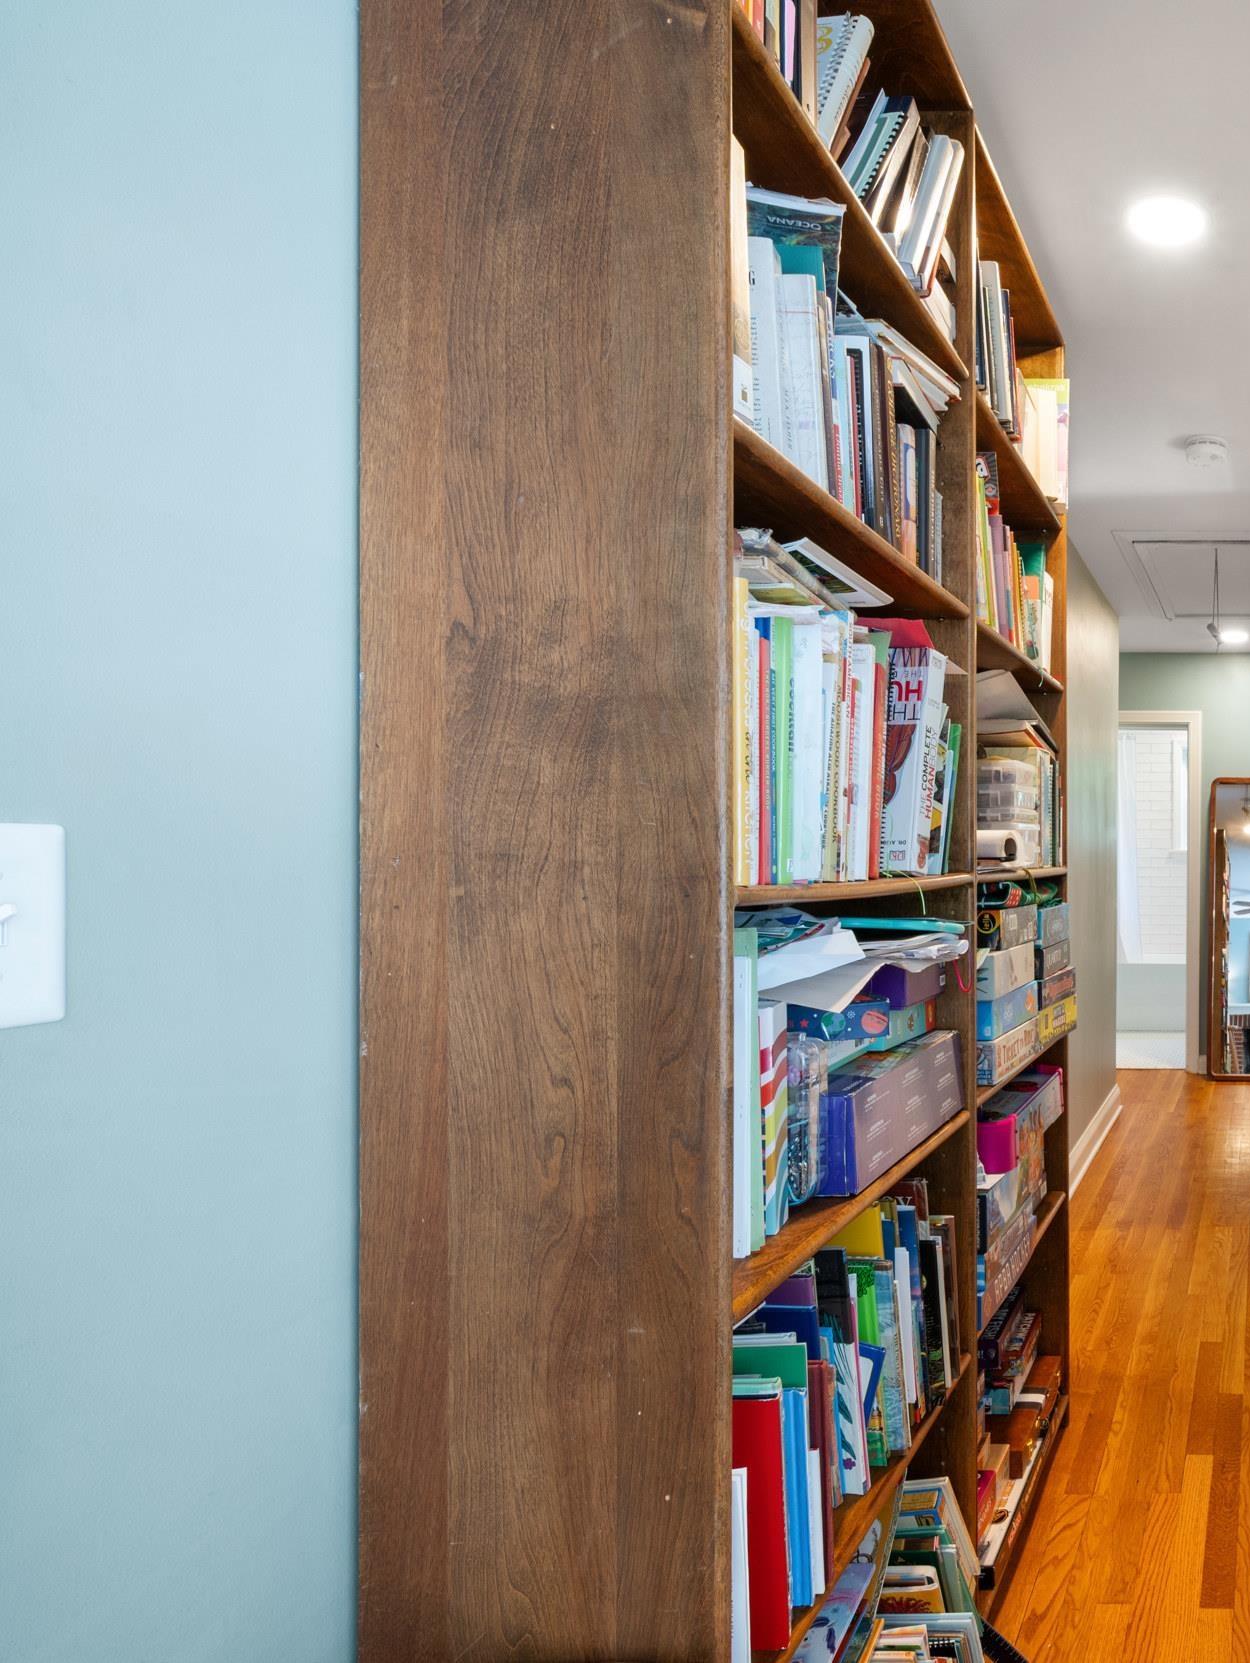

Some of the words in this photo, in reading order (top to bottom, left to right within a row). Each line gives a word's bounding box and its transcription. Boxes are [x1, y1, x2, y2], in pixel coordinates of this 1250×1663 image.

[746, 215, 822, 231] OCEANA
[887, 379, 898, 448] COLLEGE
[891, 451, 902, 538] DICTIONARY
[834, 684, 842, 767] MOOSEWOOD
[921, 727, 933, 791] COMPLETE
[832, 770, 840, 844] COOKBOOK
[920, 790, 928, 815] THE
[924, 766, 936, 820] HUMAN
[1002, 1039, 1019, 1064] TICKET
[1024, 1028, 1034, 1044] RIDE
